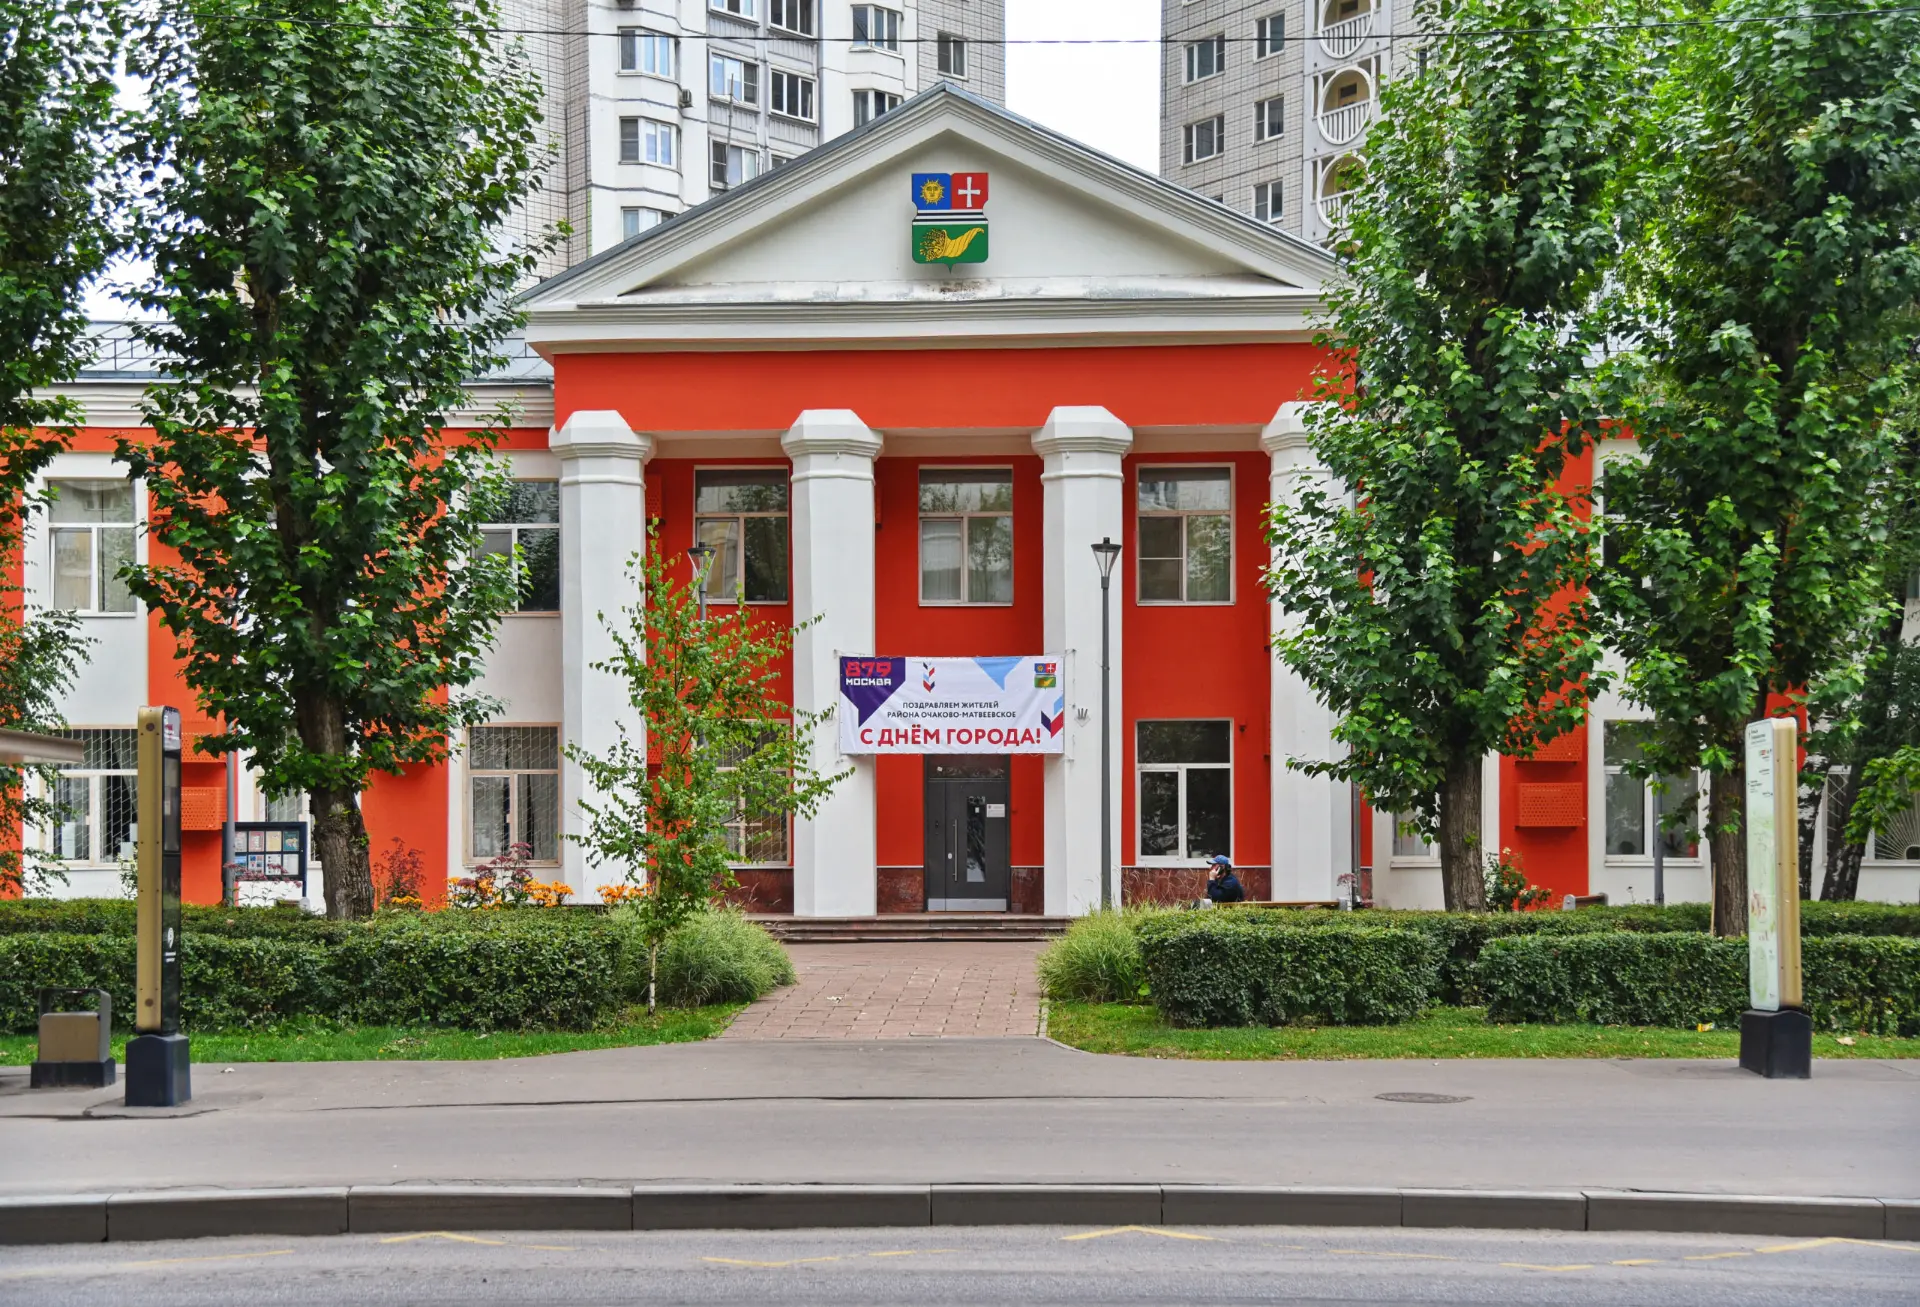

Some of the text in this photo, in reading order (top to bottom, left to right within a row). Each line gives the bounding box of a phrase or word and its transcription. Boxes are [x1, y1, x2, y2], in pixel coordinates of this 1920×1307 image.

[846, 661, 892, 677] 879
[846, 678, 892, 686] МОСКВА
[860, 724, 1041, 747] С ДНЁМ ГОРОДА!
